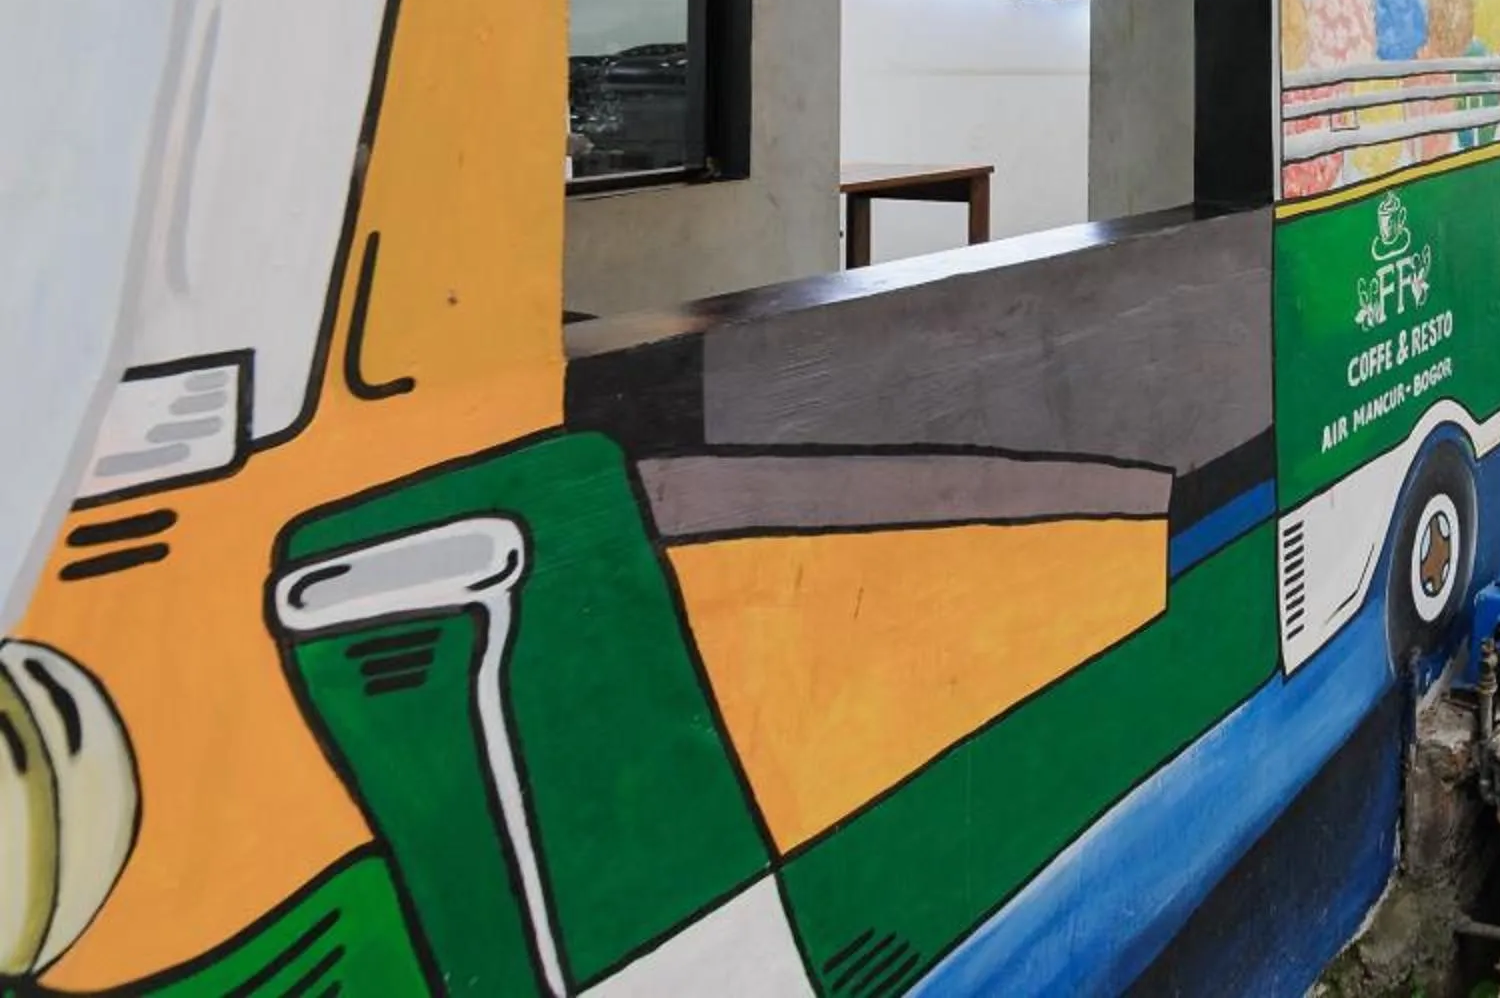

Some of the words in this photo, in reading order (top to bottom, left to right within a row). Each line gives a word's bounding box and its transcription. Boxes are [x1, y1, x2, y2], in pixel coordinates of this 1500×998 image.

[1376, 256, 1417, 323] FF
[1347, 339, 1394, 388] COFFE
[1396, 329, 1409, 365] &
[1411, 309, 1454, 358] RESTO
[1321, 415, 1349, 454] AIR
[1352, 382, 1406, 433] MANCUR
[1413, 357, 1453, 397] BOGOR
